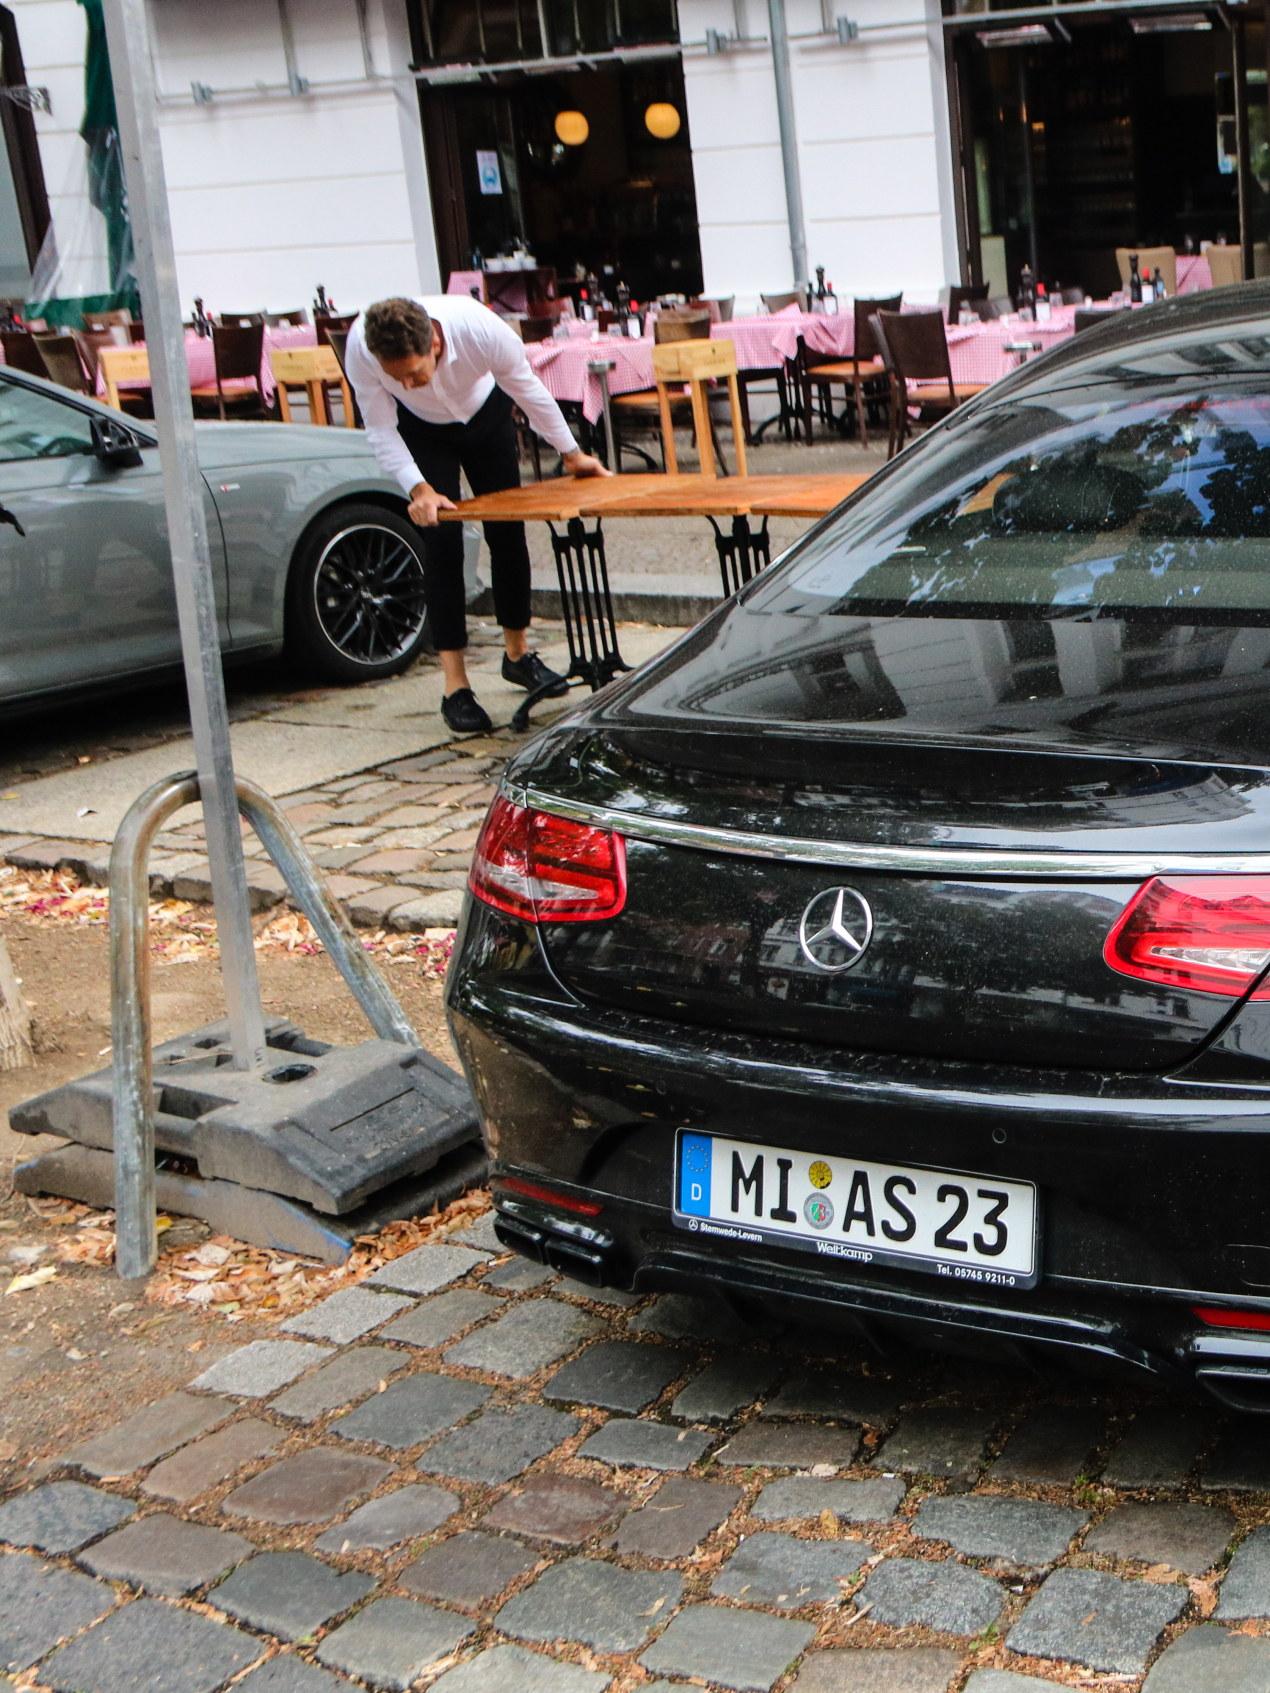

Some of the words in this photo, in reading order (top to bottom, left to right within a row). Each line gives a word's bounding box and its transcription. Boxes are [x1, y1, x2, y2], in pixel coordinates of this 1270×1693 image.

[691, 1182, 703, 1201] D
[731, 1150, 798, 1224] MI
[842, 1169, 917, 1242] AS
[934, 1183, 1010, 1256] 23
[816, 1241, 873, 1263] Weltkamp
[954, 1266, 983, 1280] 05745
[985, 1271, 1016, 1286] 9211-0
